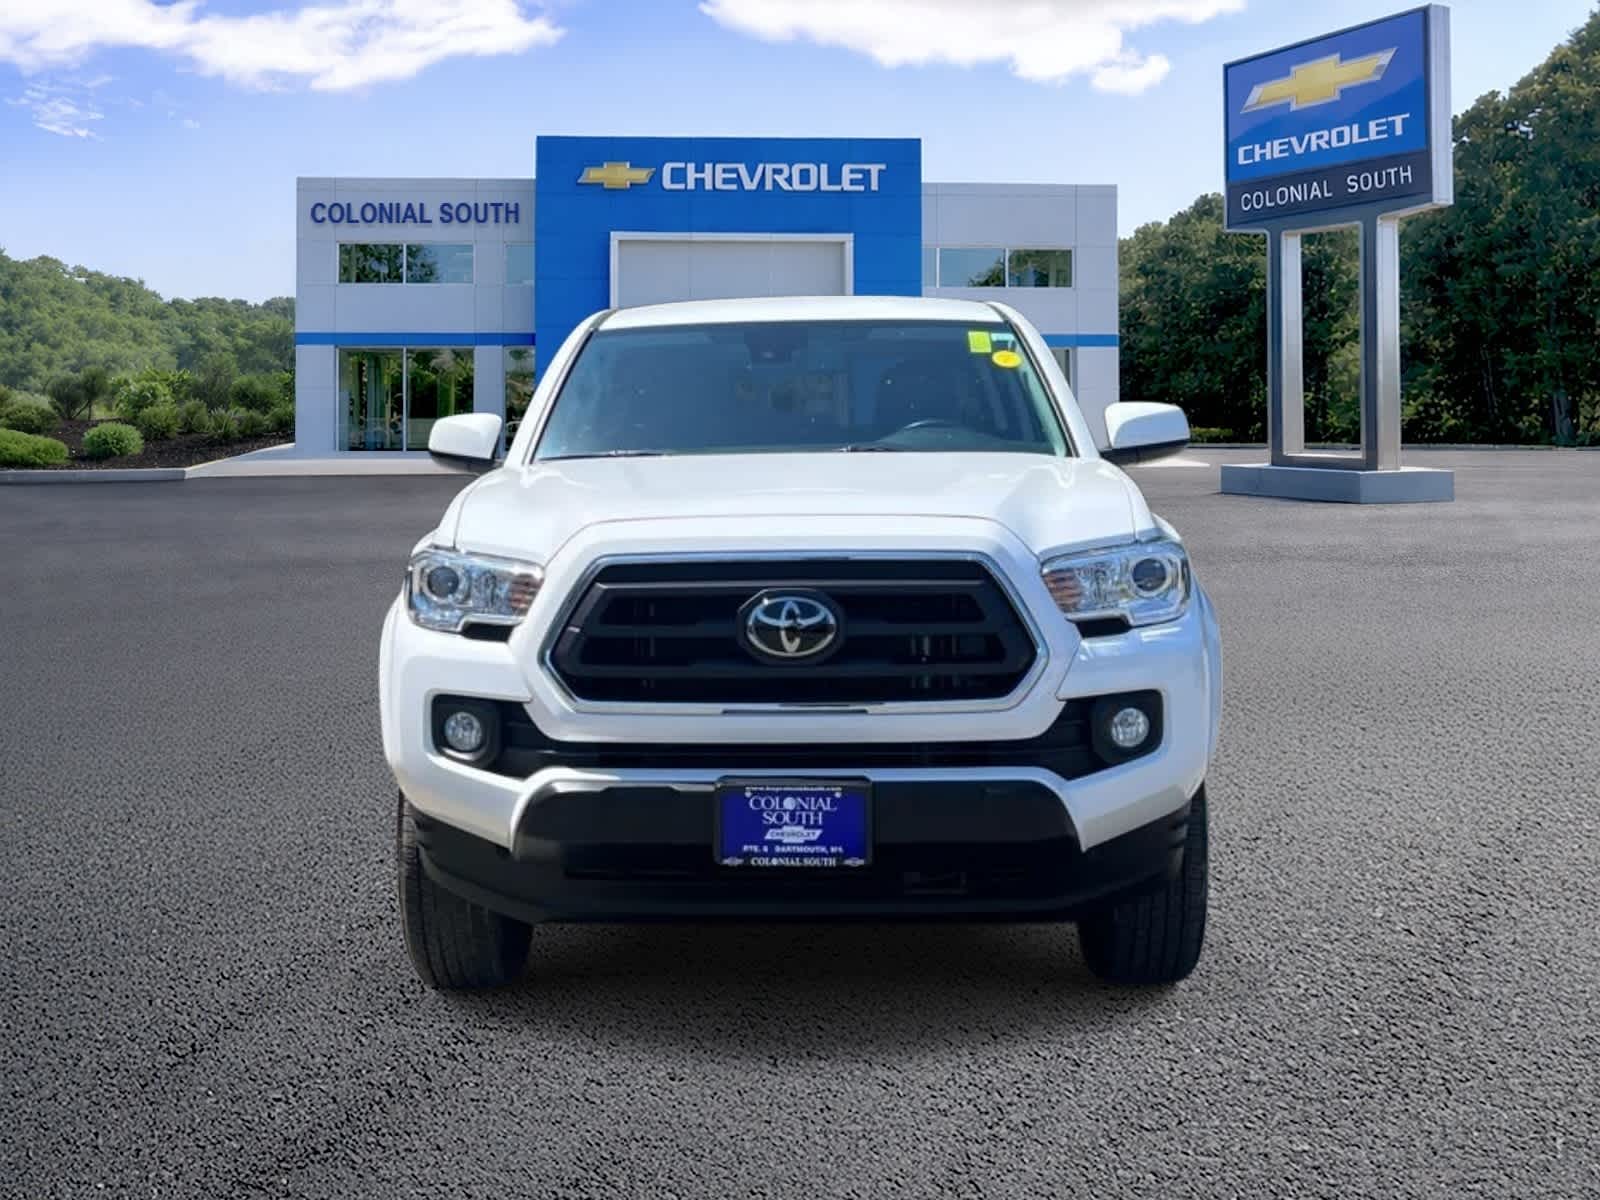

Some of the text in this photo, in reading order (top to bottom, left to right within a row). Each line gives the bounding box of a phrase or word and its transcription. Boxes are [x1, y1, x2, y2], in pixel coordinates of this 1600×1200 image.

[1237, 112, 1410, 166] CHEVROLET
[662, 162, 887, 192] CHEVROLET
[1240, 165, 1413, 211] COLONIAL SOUTH
[310, 202, 521, 226] COLONIAL SOUTH
[749, 796, 837, 811] COLONIAL
[762, 811, 823, 825] SOUTH
[750, 857, 836, 867] COLONIAL SOUTH
